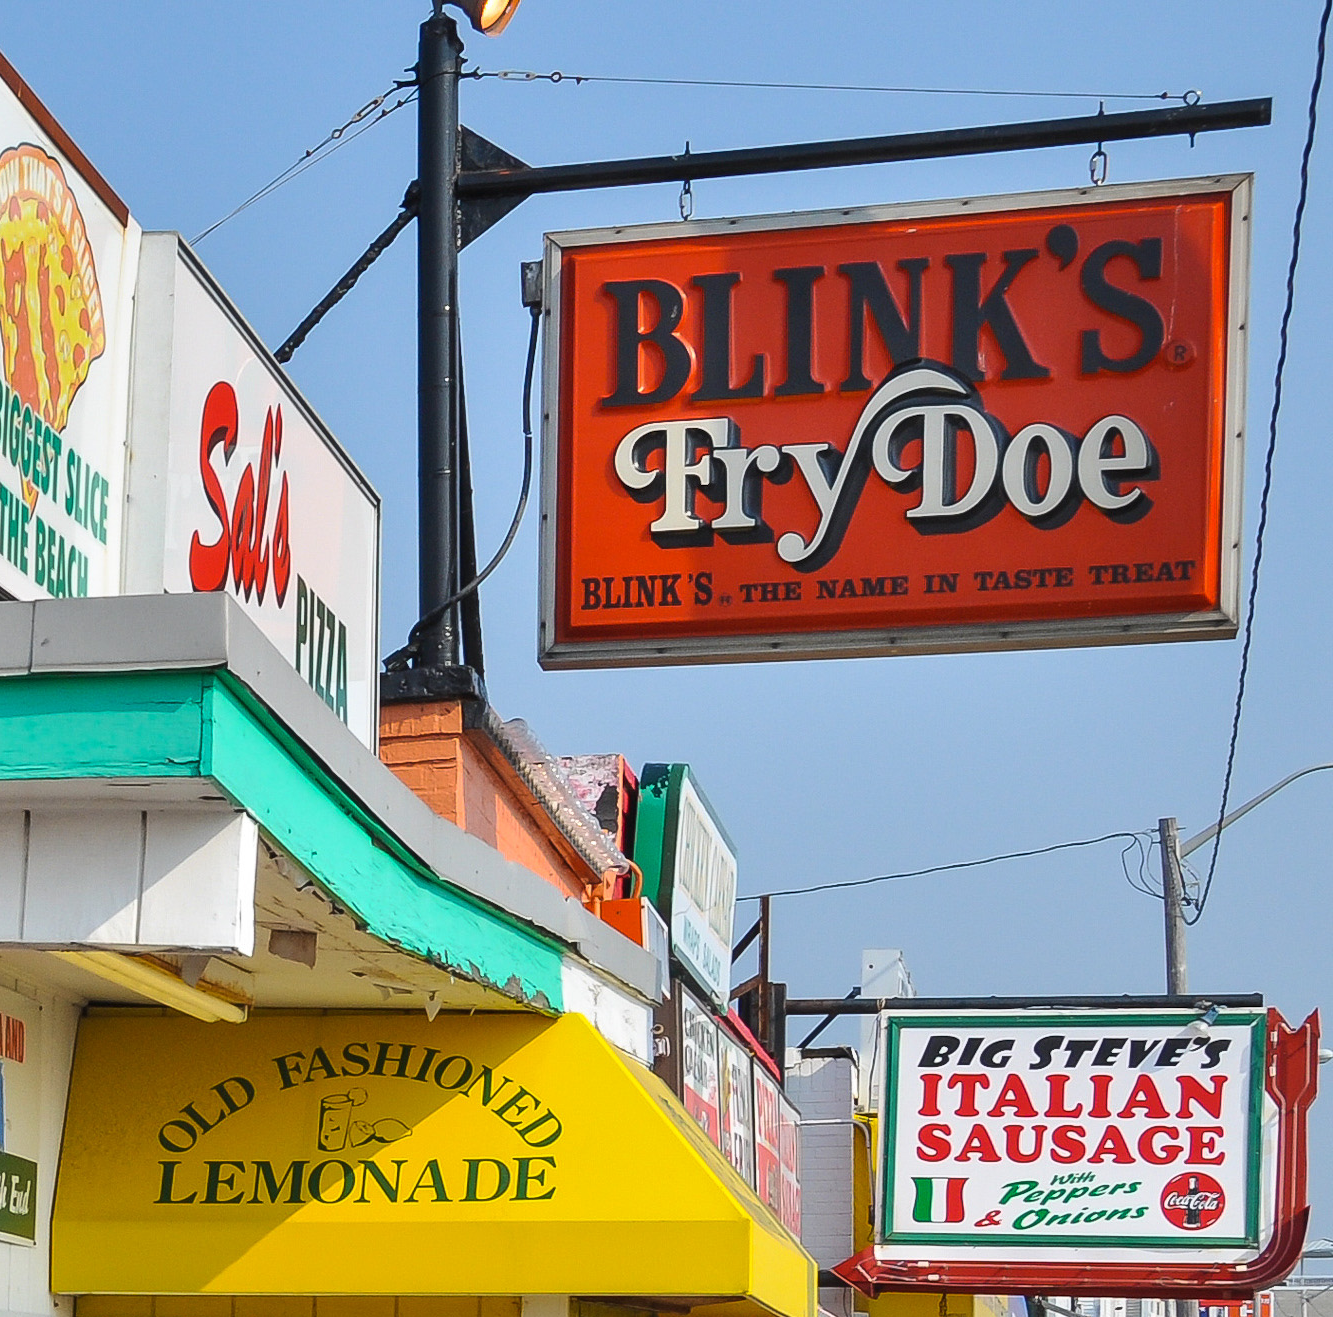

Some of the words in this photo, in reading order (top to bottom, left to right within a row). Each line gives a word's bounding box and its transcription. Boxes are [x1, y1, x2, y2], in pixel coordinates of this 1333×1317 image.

[600, 224, 1166, 408] BLINK'S
[614, 362, 973, 570] Fry
[872, 402, 1159, 534] Doe
[65, 446, 109, 545] SLICE
[189, 380, 291, 609] Sal's
[0, 482, 30, 575] THE
[33, 514, 89, 599] BEACH
[581, 571, 713, 610] BLINK'S
[740, 582, 803, 603] THE
[816, 576, 909, 599] NAME
[924, 573, 960, 595] IN
[974, 567, 1074, 591] TASTE
[1090, 561, 1195, 585] TREAT
[296, 573, 348, 727] PIZZA
[5, 1016, 26, 1063] AND
[918, 1035, 1015, 1068] BIG
[1029, 1035, 1231, 1070] STEVE'S
[158, 1075, 255, 1154] OLD
[272, 1041, 564, 1150] FASHIONED
[917, 1074, 1228, 1119] ITALIAN
[917, 1124, 1225, 1165] SAUSAGE
[9, 1175, 31, 1216] End
[153, 1156, 557, 1204] LEMONADE
[999, 1178, 1143, 1205] Peppers
[1163, 1191, 1220, 1214] Coca-Cola
[974, 1210, 1002, 1228] &
[1012, 1203, 1149, 1230] Onions
